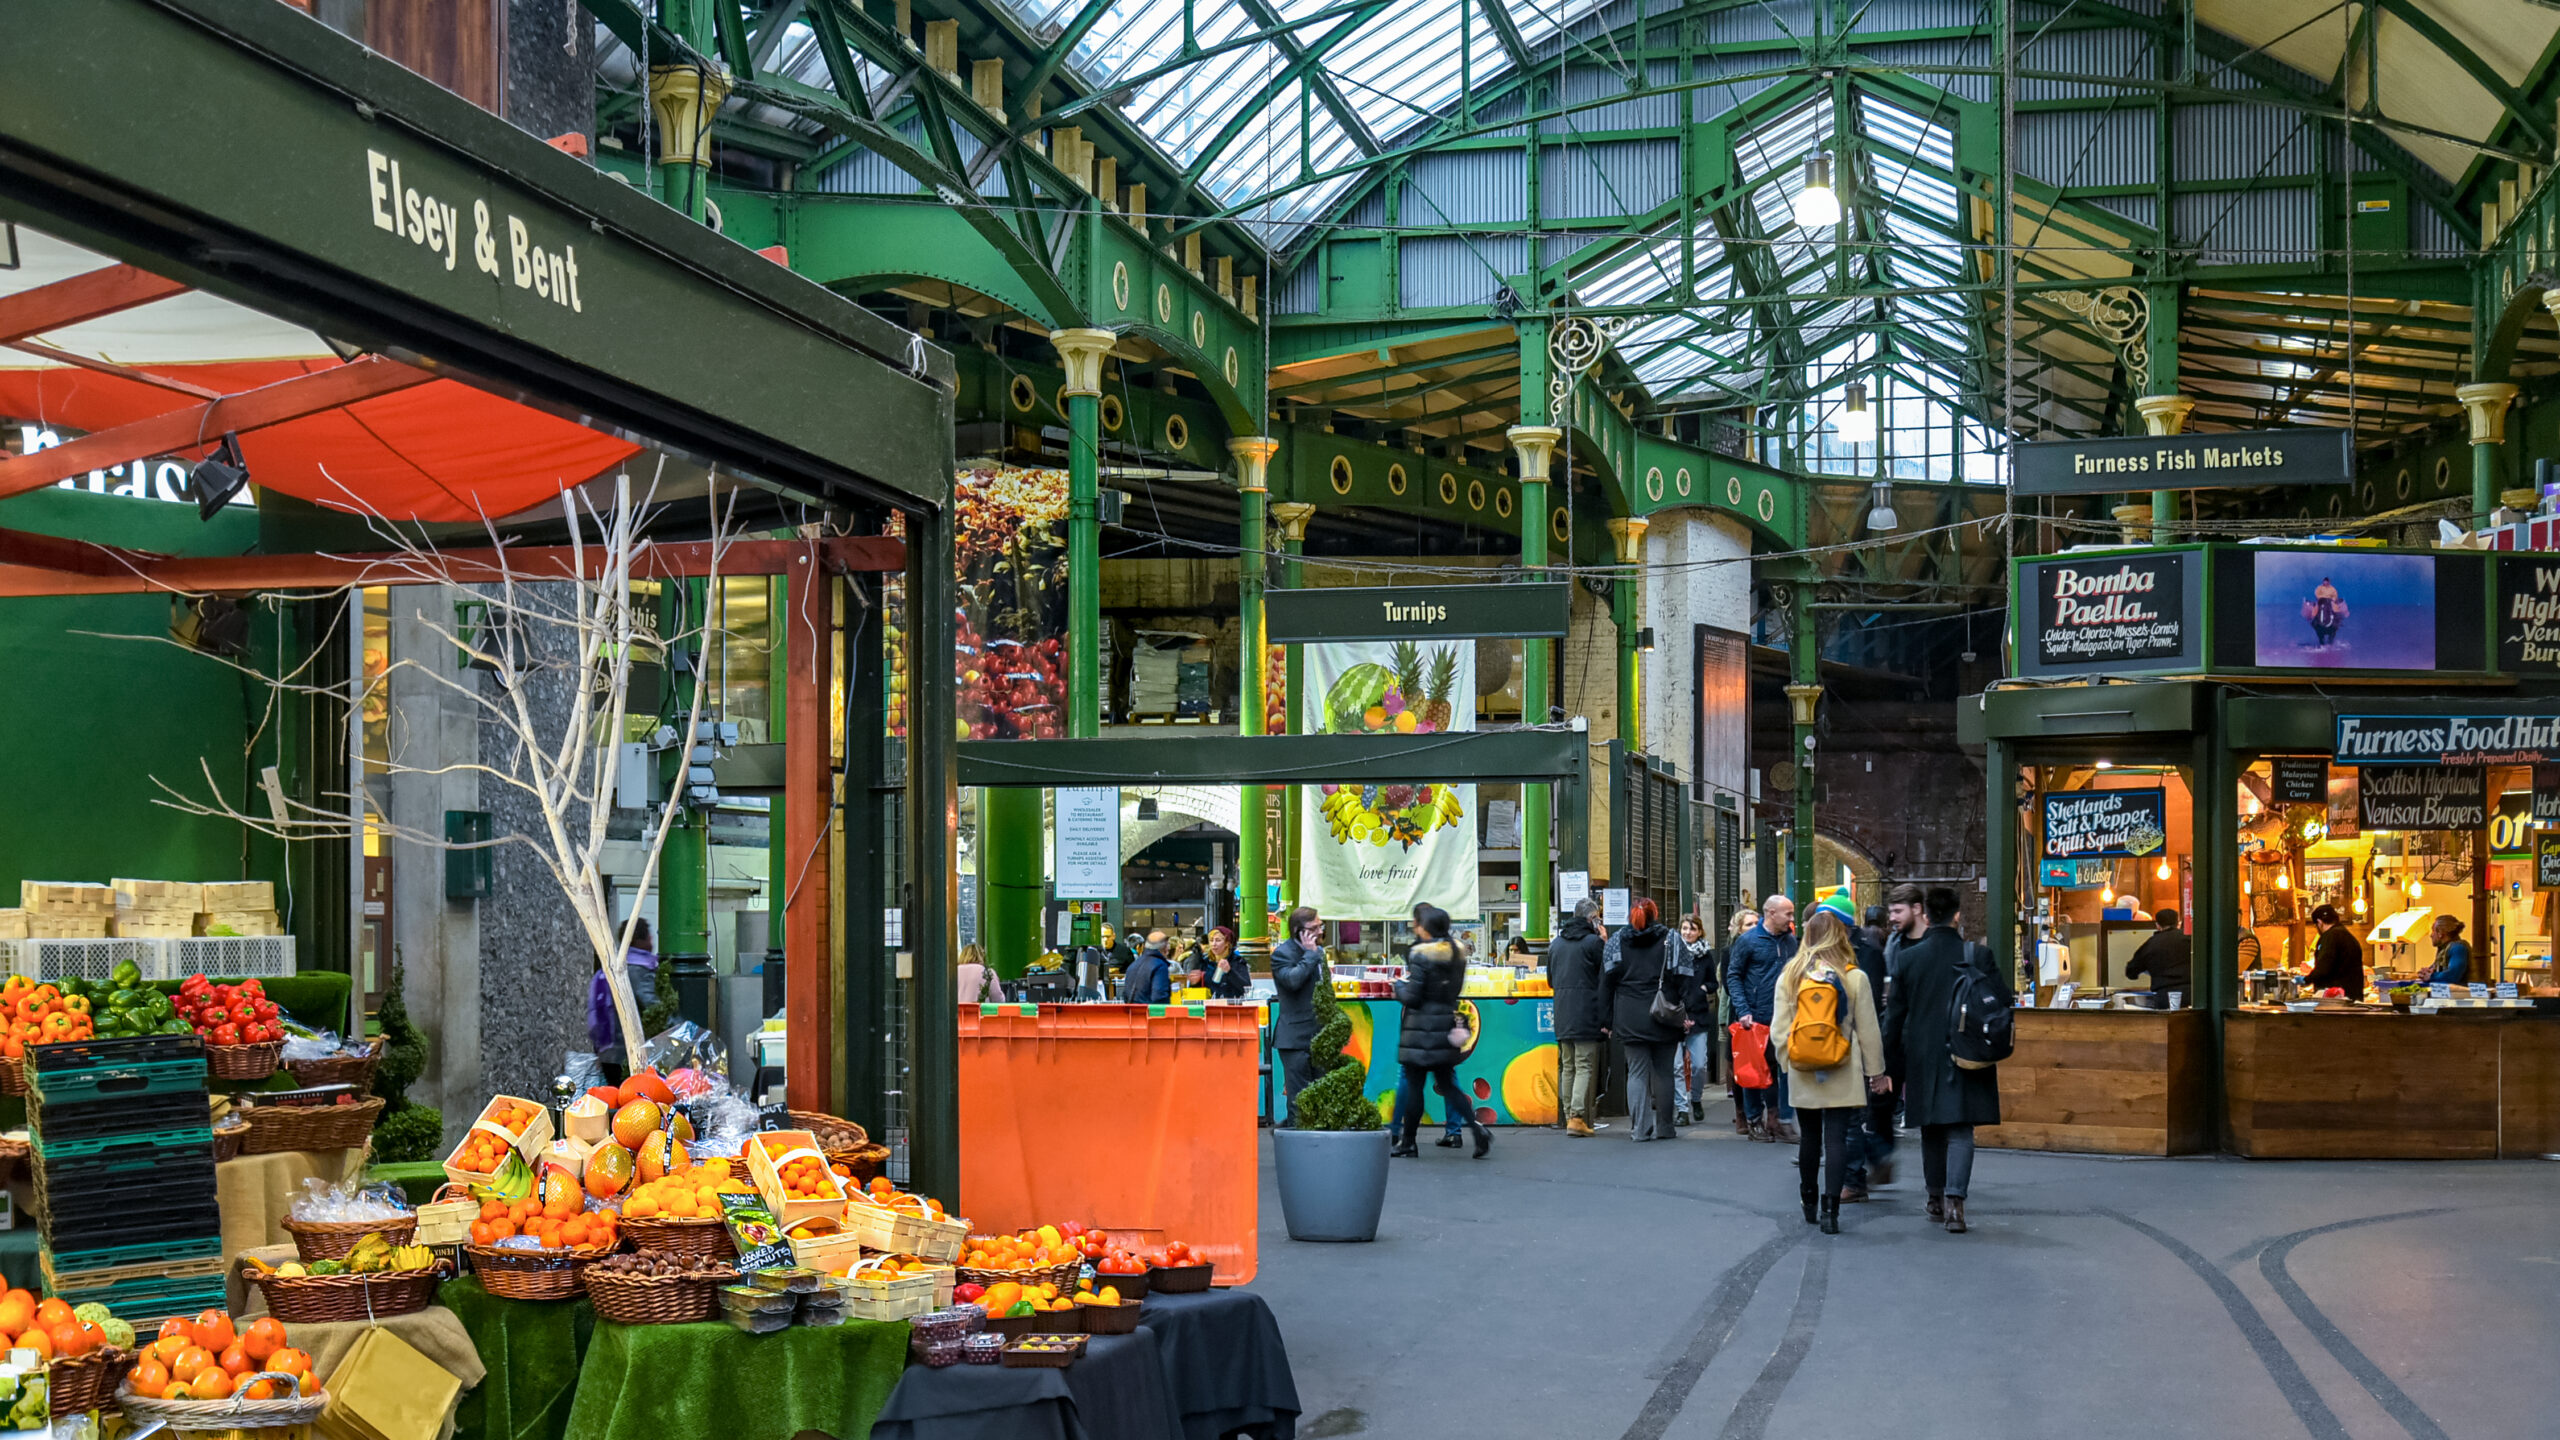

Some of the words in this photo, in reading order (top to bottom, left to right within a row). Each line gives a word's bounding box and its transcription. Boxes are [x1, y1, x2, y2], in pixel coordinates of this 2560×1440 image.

[367, 149, 457, 271] Elsey
[474, 199, 499, 278] &
[508, 214, 581, 313] Bent
[2075, 453, 2149, 475] Furness
[2156, 449, 2196, 471] Fish
[2203, 446, 2283, 469] Markets
[2053, 565, 2155, 599] Bomba
[1383, 600, 1447, 625] Turnips
[2055, 595, 2158, 627] Paella...
[2125, 636, 2148, 655] Tiger
[2338, 719, 2446, 756] Furness
[2446, 716, 2512, 751] Food
[2512, 716, 2560, 749] Hut
[2440, 751, 2475, 766] Freshly
[2476, 750, 2517, 764] Prepared
[2285, 780, 2315, 789] Chicken
[2289, 790, 2312, 799] Curry
[2363, 767, 2421, 796] Scottish
[2423, 767, 2480, 801] Highland
[2047, 793, 2123, 821] Shetlands
[2363, 797, 2421, 826] Venison
[2422, 797, 2483, 830] Burgers
[2049, 817, 2079, 838] Salt
[2080, 815, 2091, 832] &
[2092, 808, 2150, 832] Pepper
[2046, 834, 2085, 858] Chilli
[2086, 826, 2129, 853] Squid
[1359, 865, 1384, 880] love
[1383, 864, 1418, 885] fruit
[434, 1247, 456, 1257] FENIX
[740, 1245, 775, 1266] COOKED
